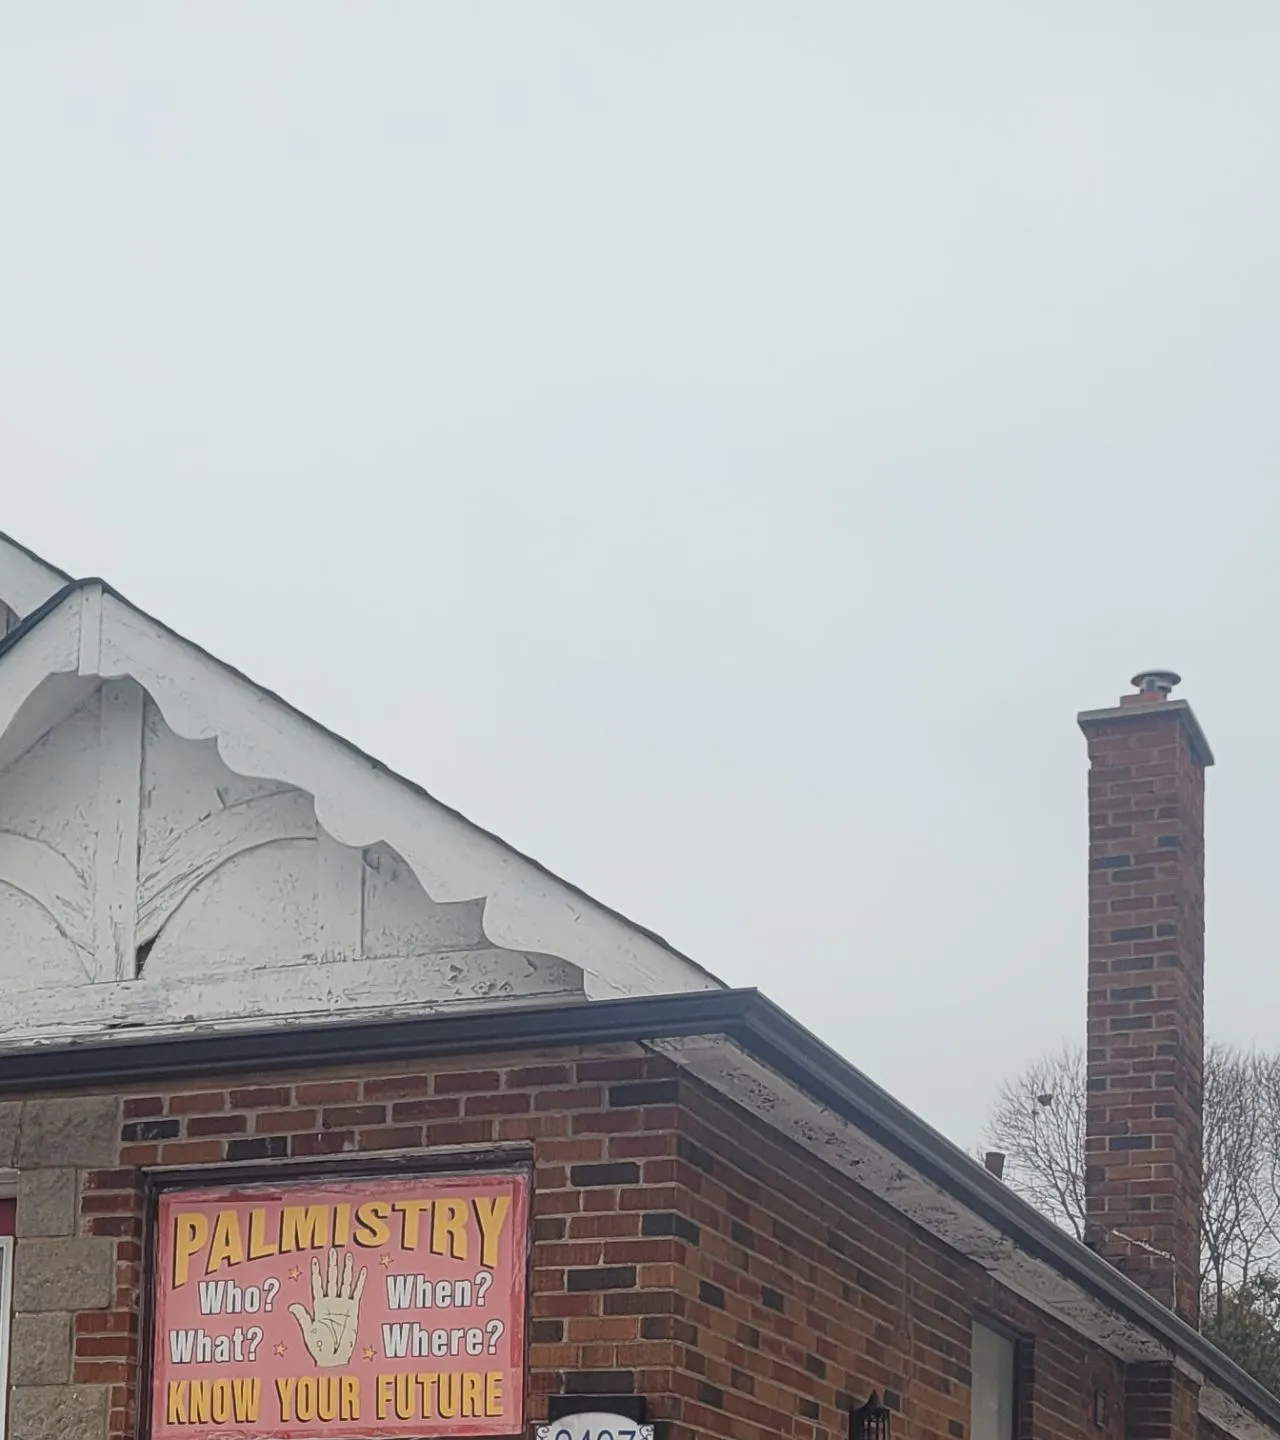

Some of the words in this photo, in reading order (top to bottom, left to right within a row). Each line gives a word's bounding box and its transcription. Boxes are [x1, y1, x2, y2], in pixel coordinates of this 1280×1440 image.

[172, 1195, 512, 1290] PALMISTRY
[198, 1277, 281, 1316] Who?
[386, 1271, 493, 1312] When?
[168, 1325, 264, 1365] What?
[381, 1320, 505, 1358] Where?
[167, 1377, 261, 1426] KNOW
[275, 1374, 361, 1422] YOUR
[376, 1371, 505, 1419] FUTURE
